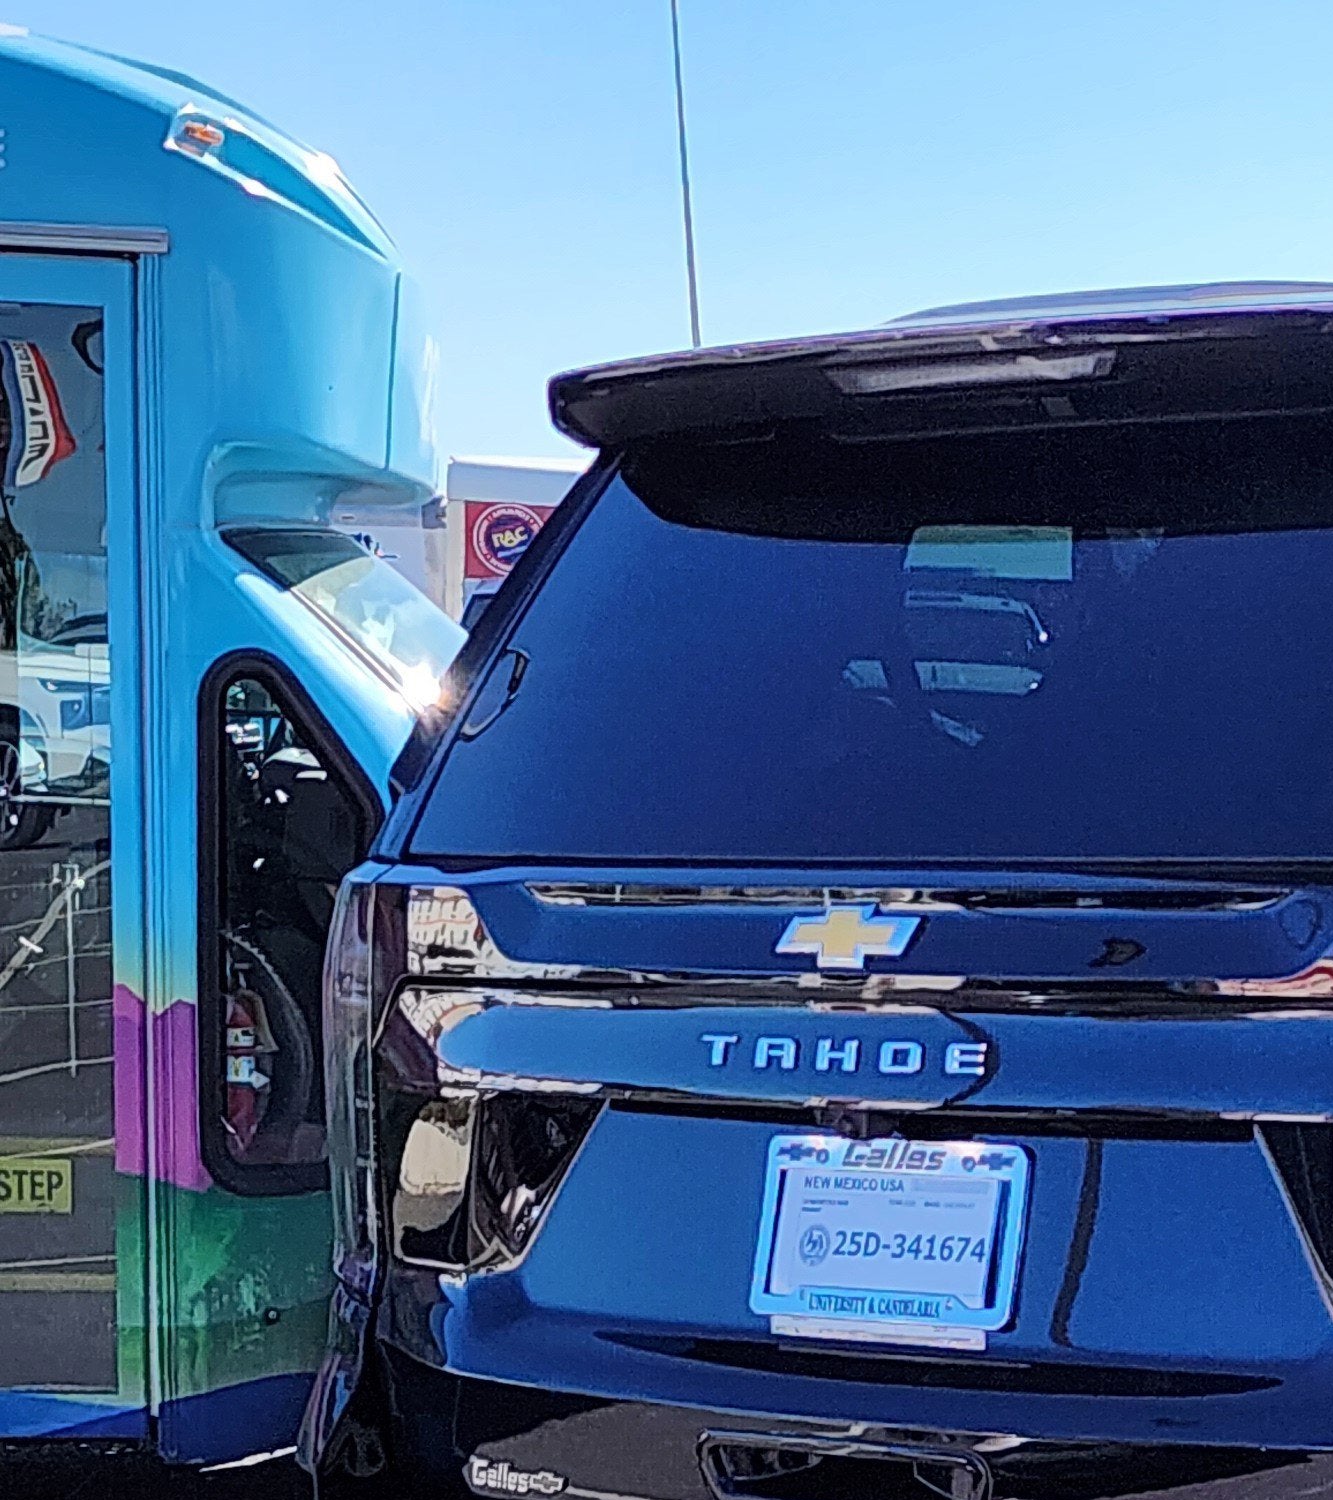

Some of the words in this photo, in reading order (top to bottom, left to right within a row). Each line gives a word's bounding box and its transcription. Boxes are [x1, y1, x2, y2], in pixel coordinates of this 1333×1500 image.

[701, 1034, 988, 1077] TAHOE
[841, 1141, 947, 1171] Galles
[0, 1169, 64, 1202] STEP
[804, 1175, 831, 1190] NEW
[833, 1177, 878, 1192] MEXICO
[880, 1179, 904, 1193] USA
[831, 1230, 986, 1263] 25D-341674
[471, 1459, 529, 1493] Galles
